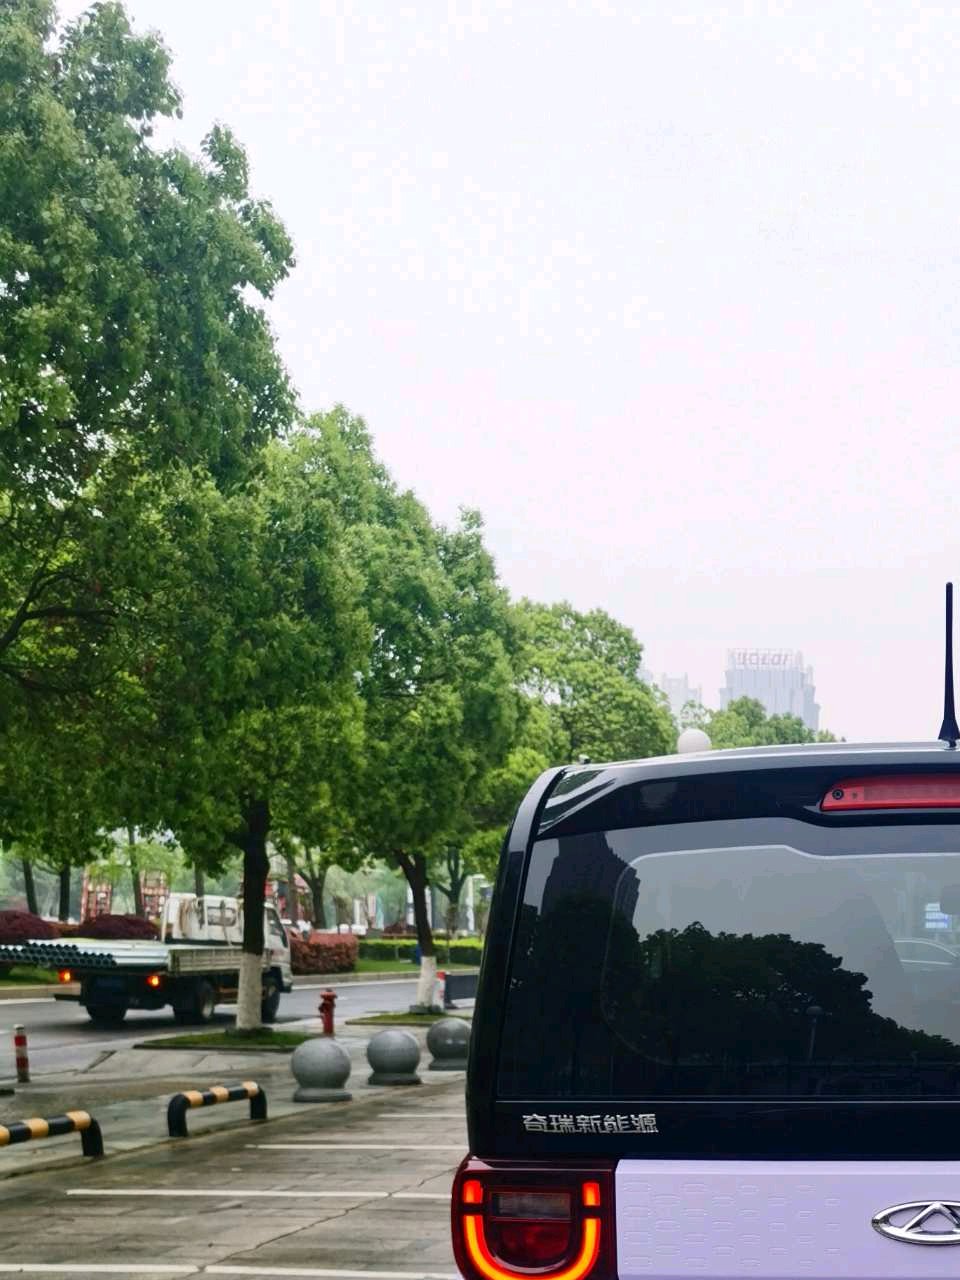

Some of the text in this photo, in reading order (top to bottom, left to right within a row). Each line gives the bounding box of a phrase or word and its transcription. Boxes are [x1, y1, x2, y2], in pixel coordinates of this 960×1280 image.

[521, 1112, 660, 1134] 奇瑞新能源
